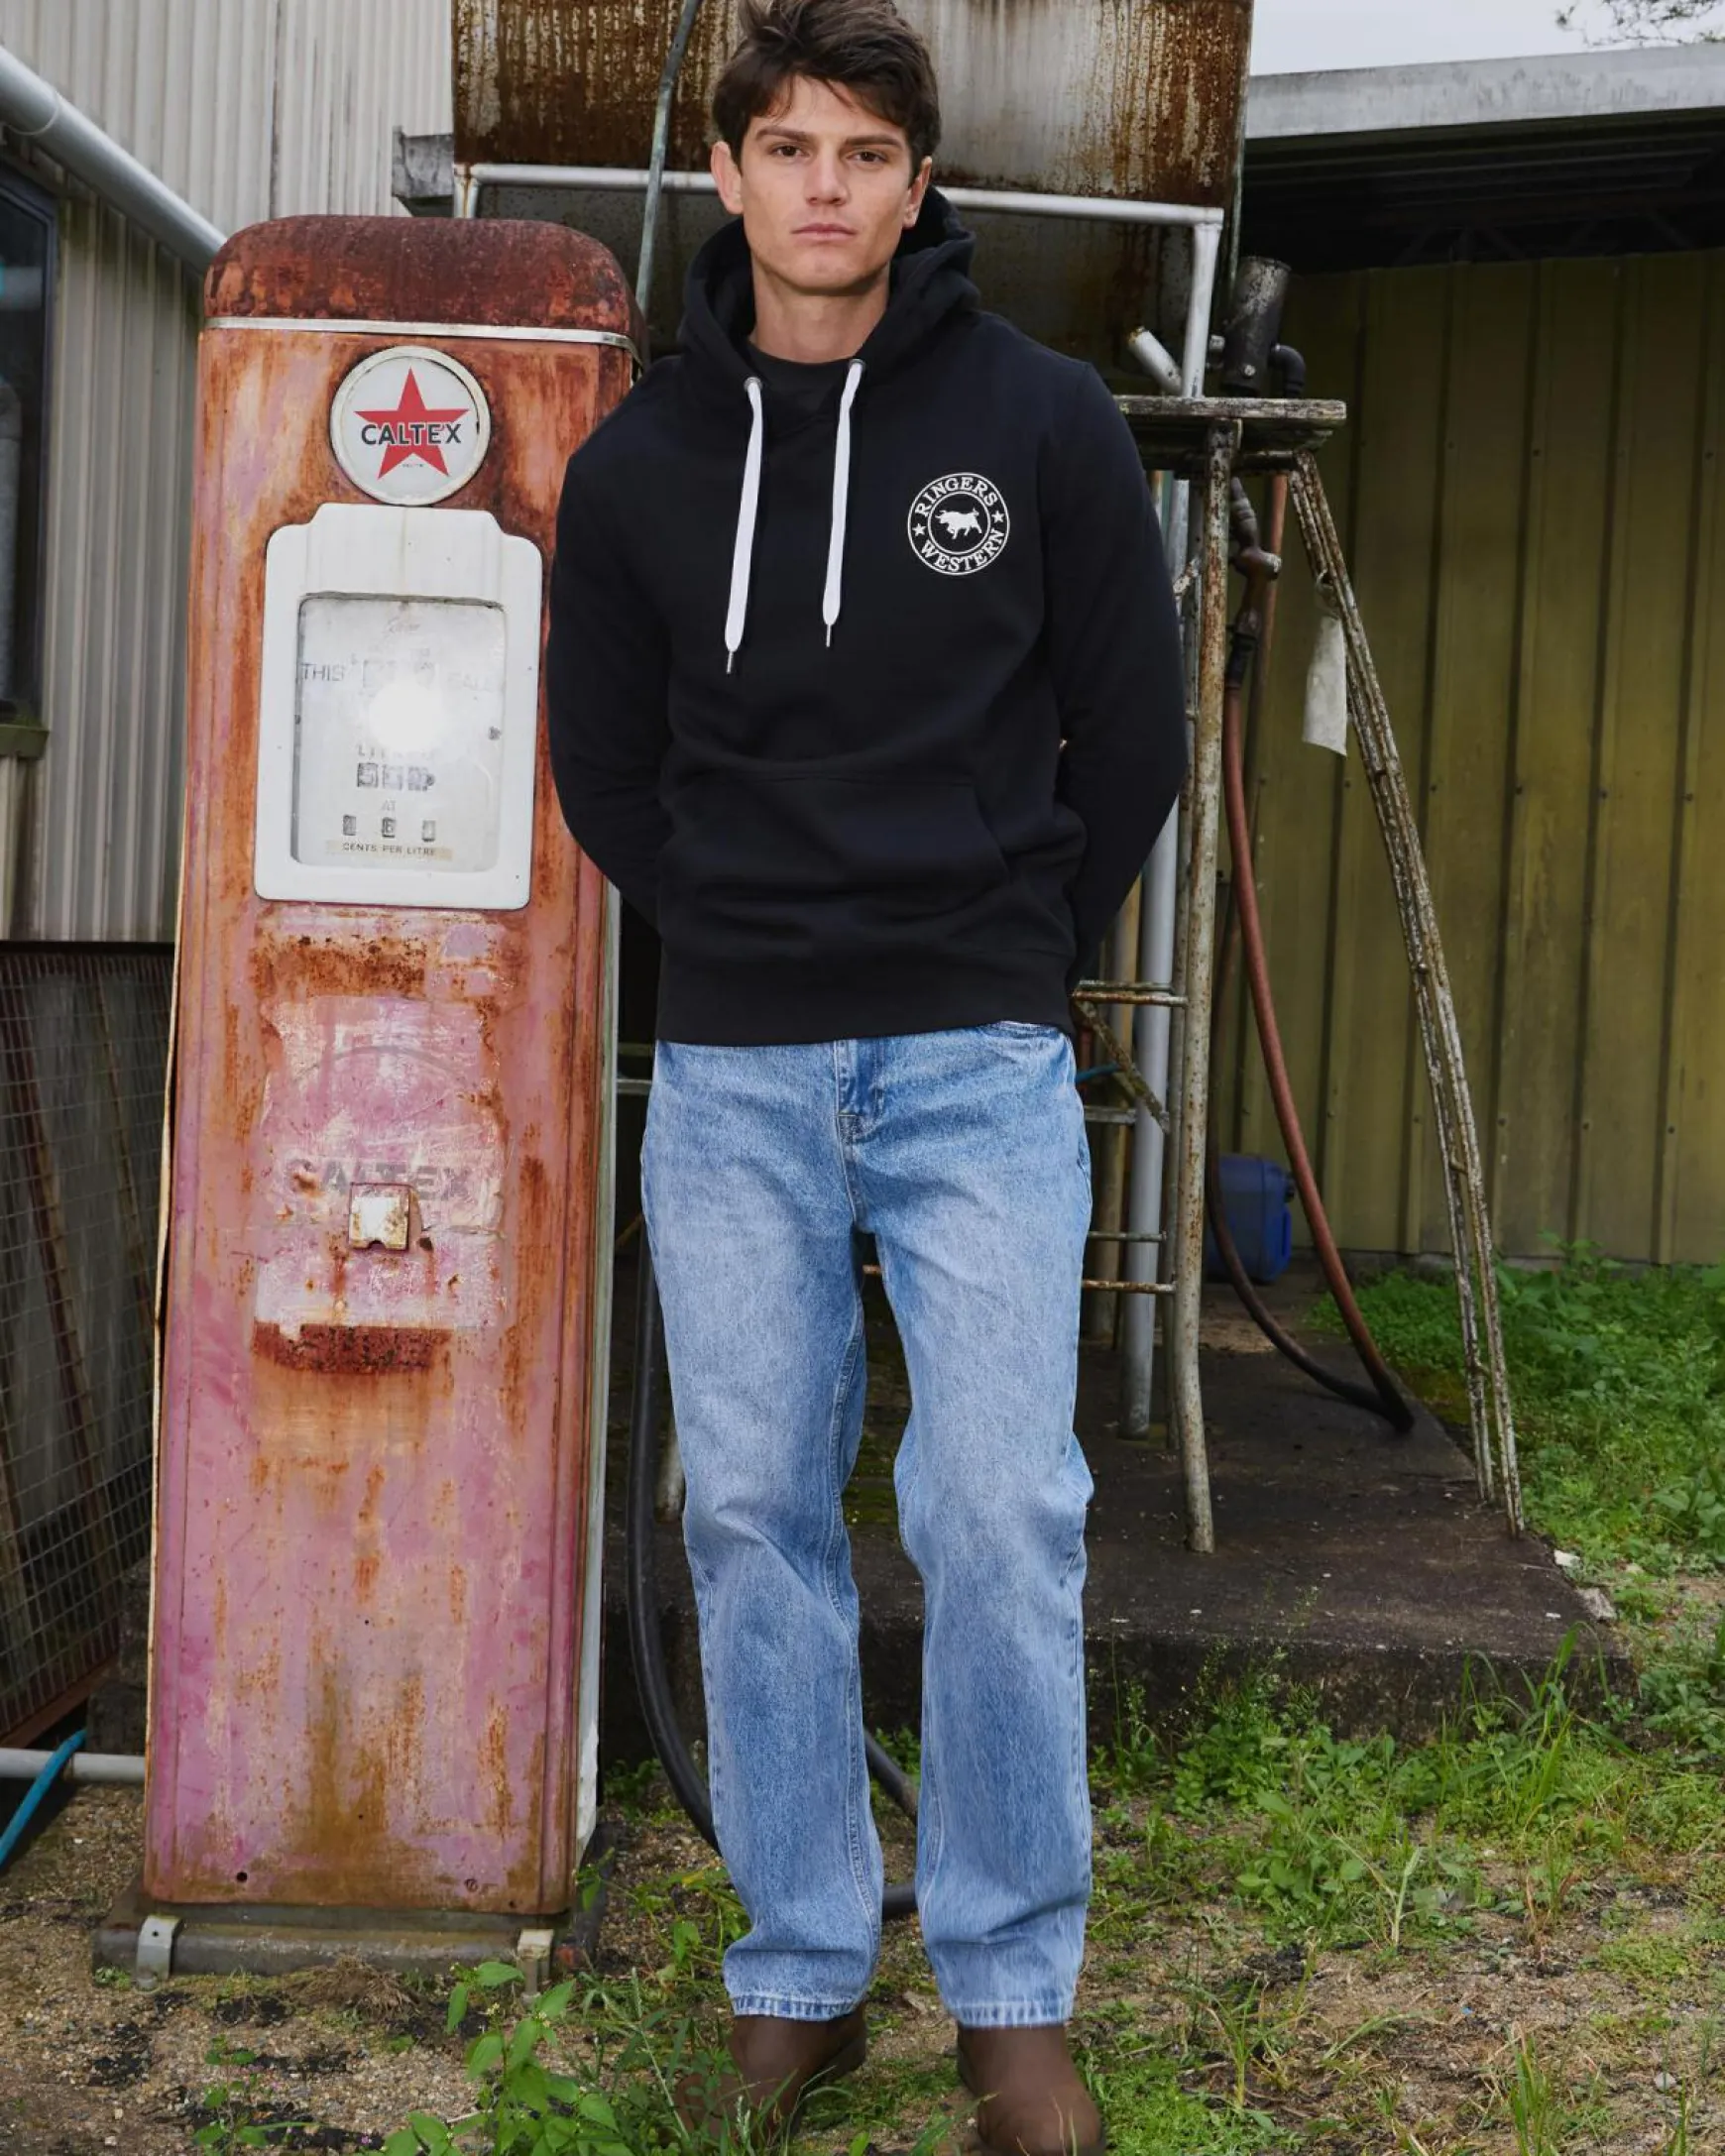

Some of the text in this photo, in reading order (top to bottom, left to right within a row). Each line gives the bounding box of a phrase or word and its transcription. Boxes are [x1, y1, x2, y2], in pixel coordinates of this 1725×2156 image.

[361, 423, 462, 445] CALTEX
[914, 476, 998, 517] RINGERS
[921, 527, 1004, 572] WESTERN
